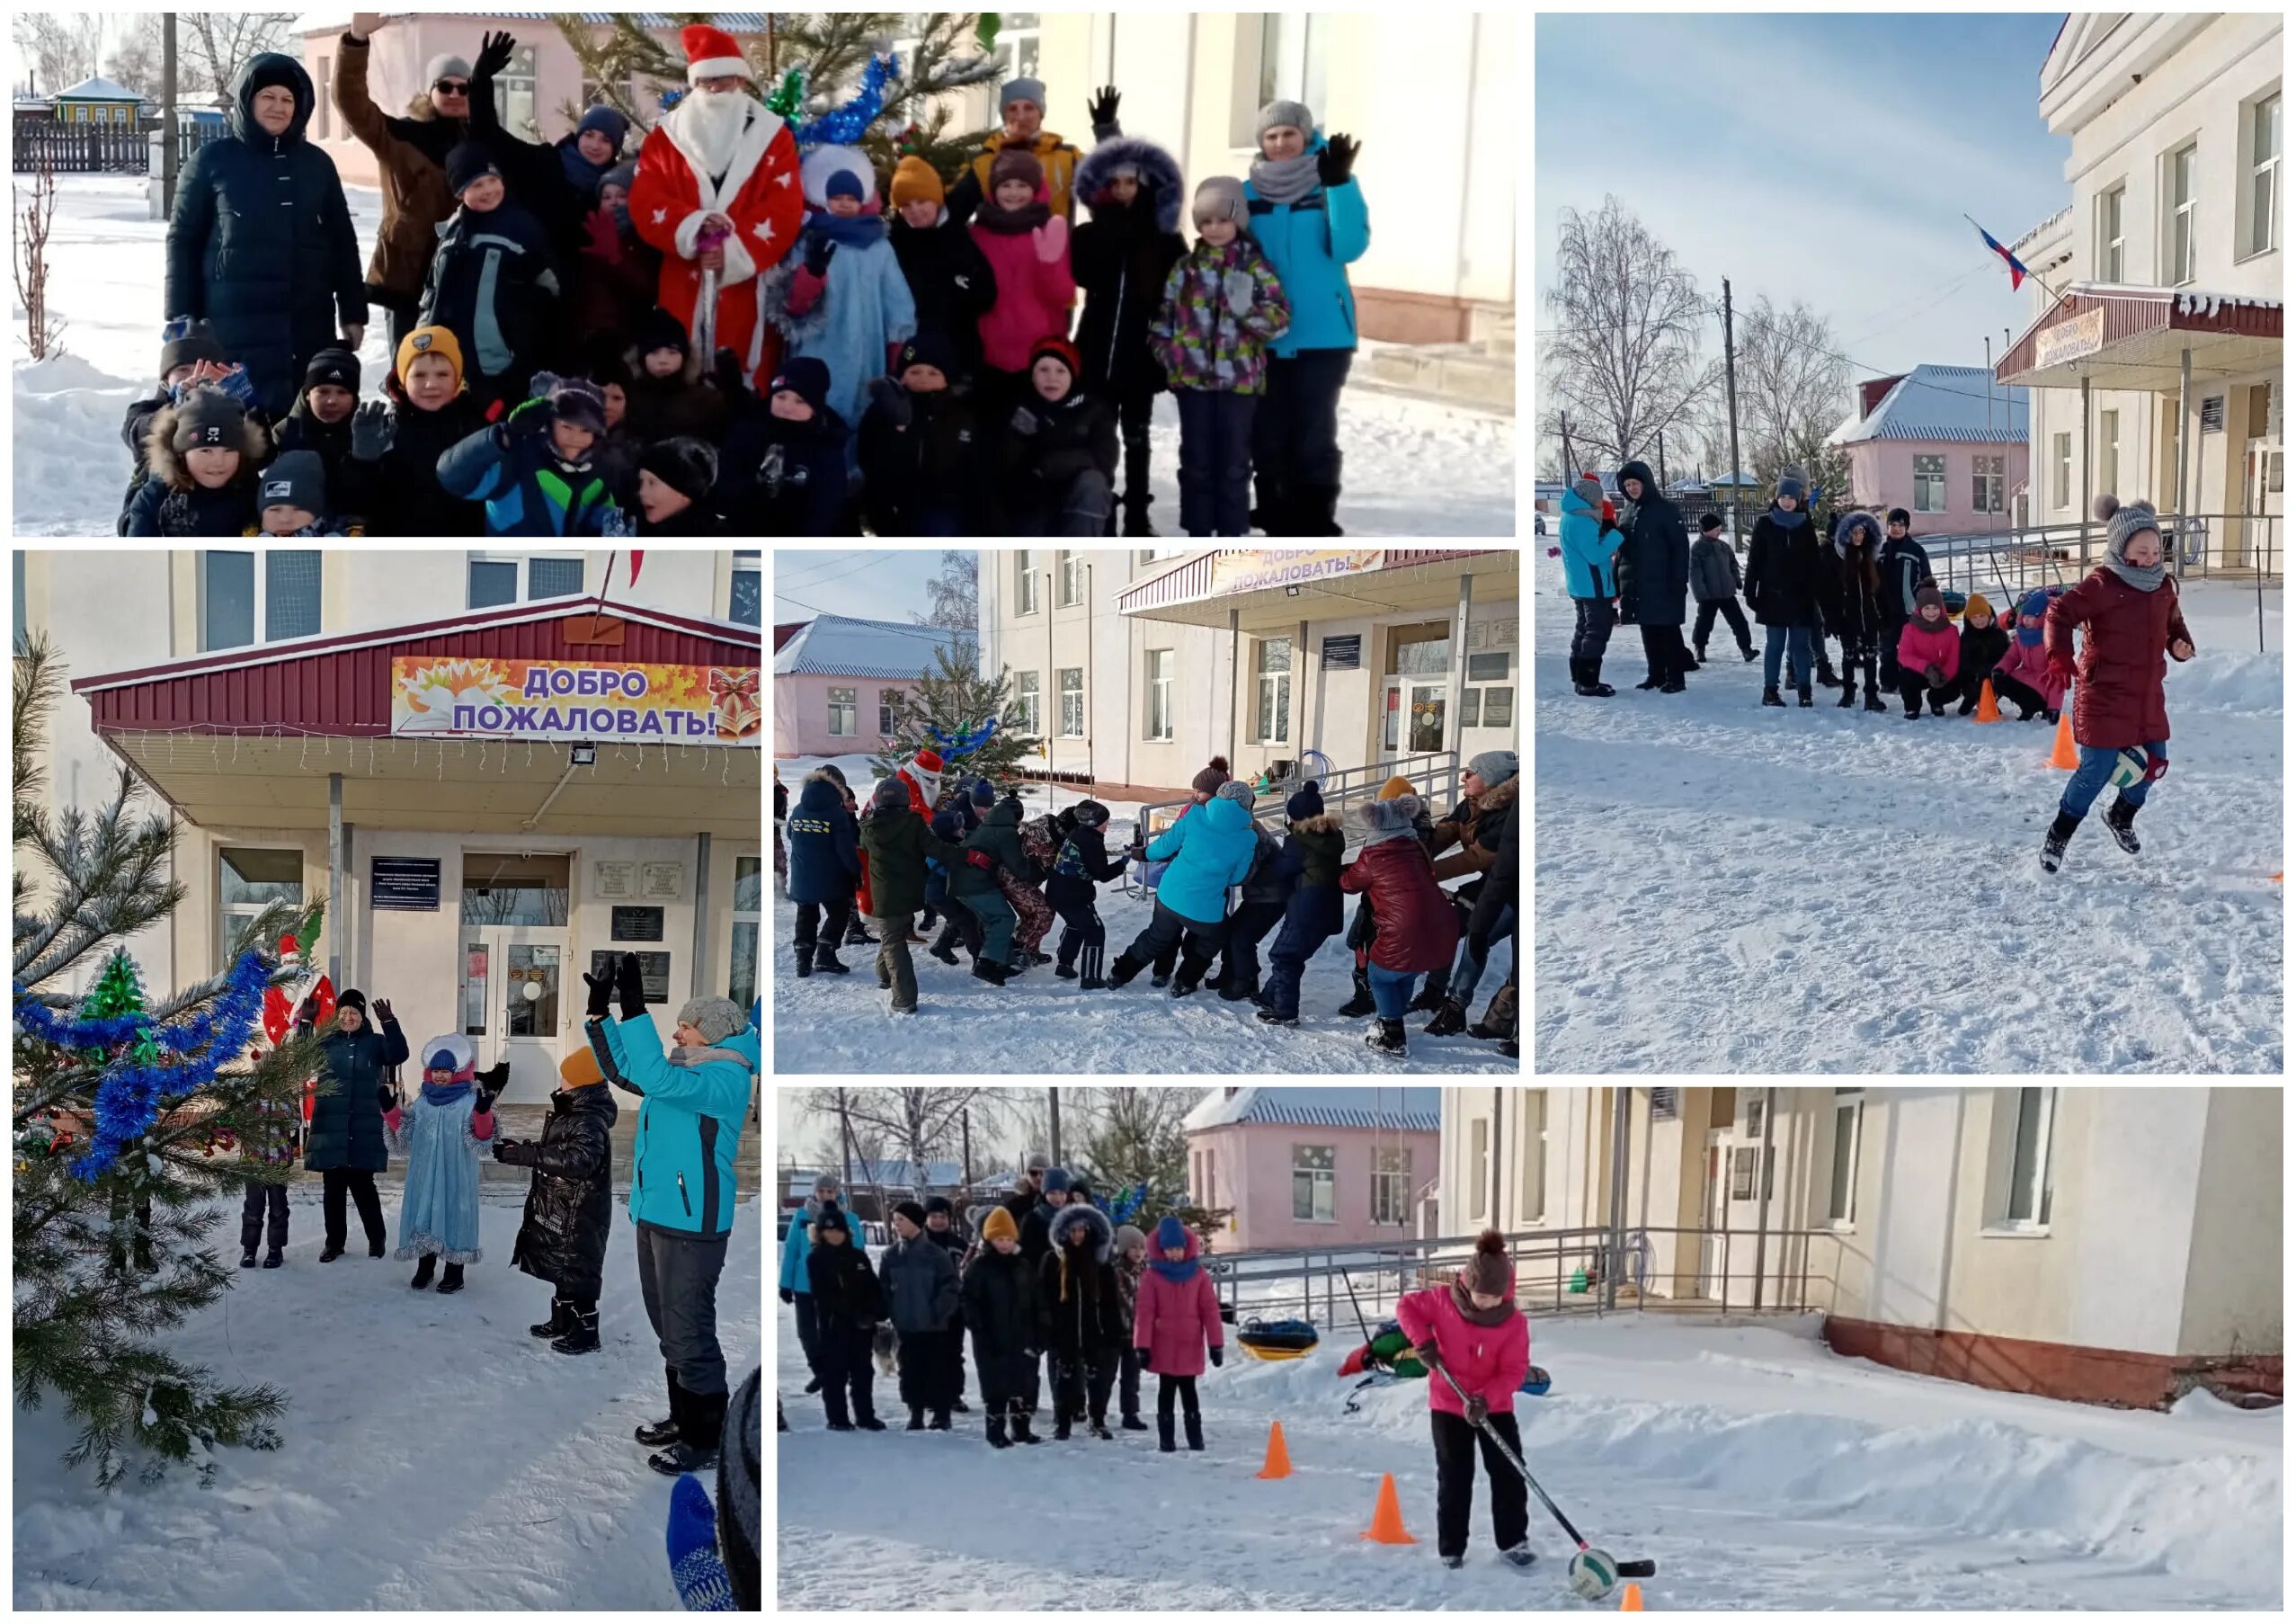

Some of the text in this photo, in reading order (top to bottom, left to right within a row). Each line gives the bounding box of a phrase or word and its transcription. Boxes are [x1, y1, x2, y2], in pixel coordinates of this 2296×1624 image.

[1234, 556, 1350, 588] ПОЖАЛОВАТЬ!
[523, 669, 646, 698] ДОБРО
[452, 705, 716, 736] ПОЖАЛОВАТЬ!
